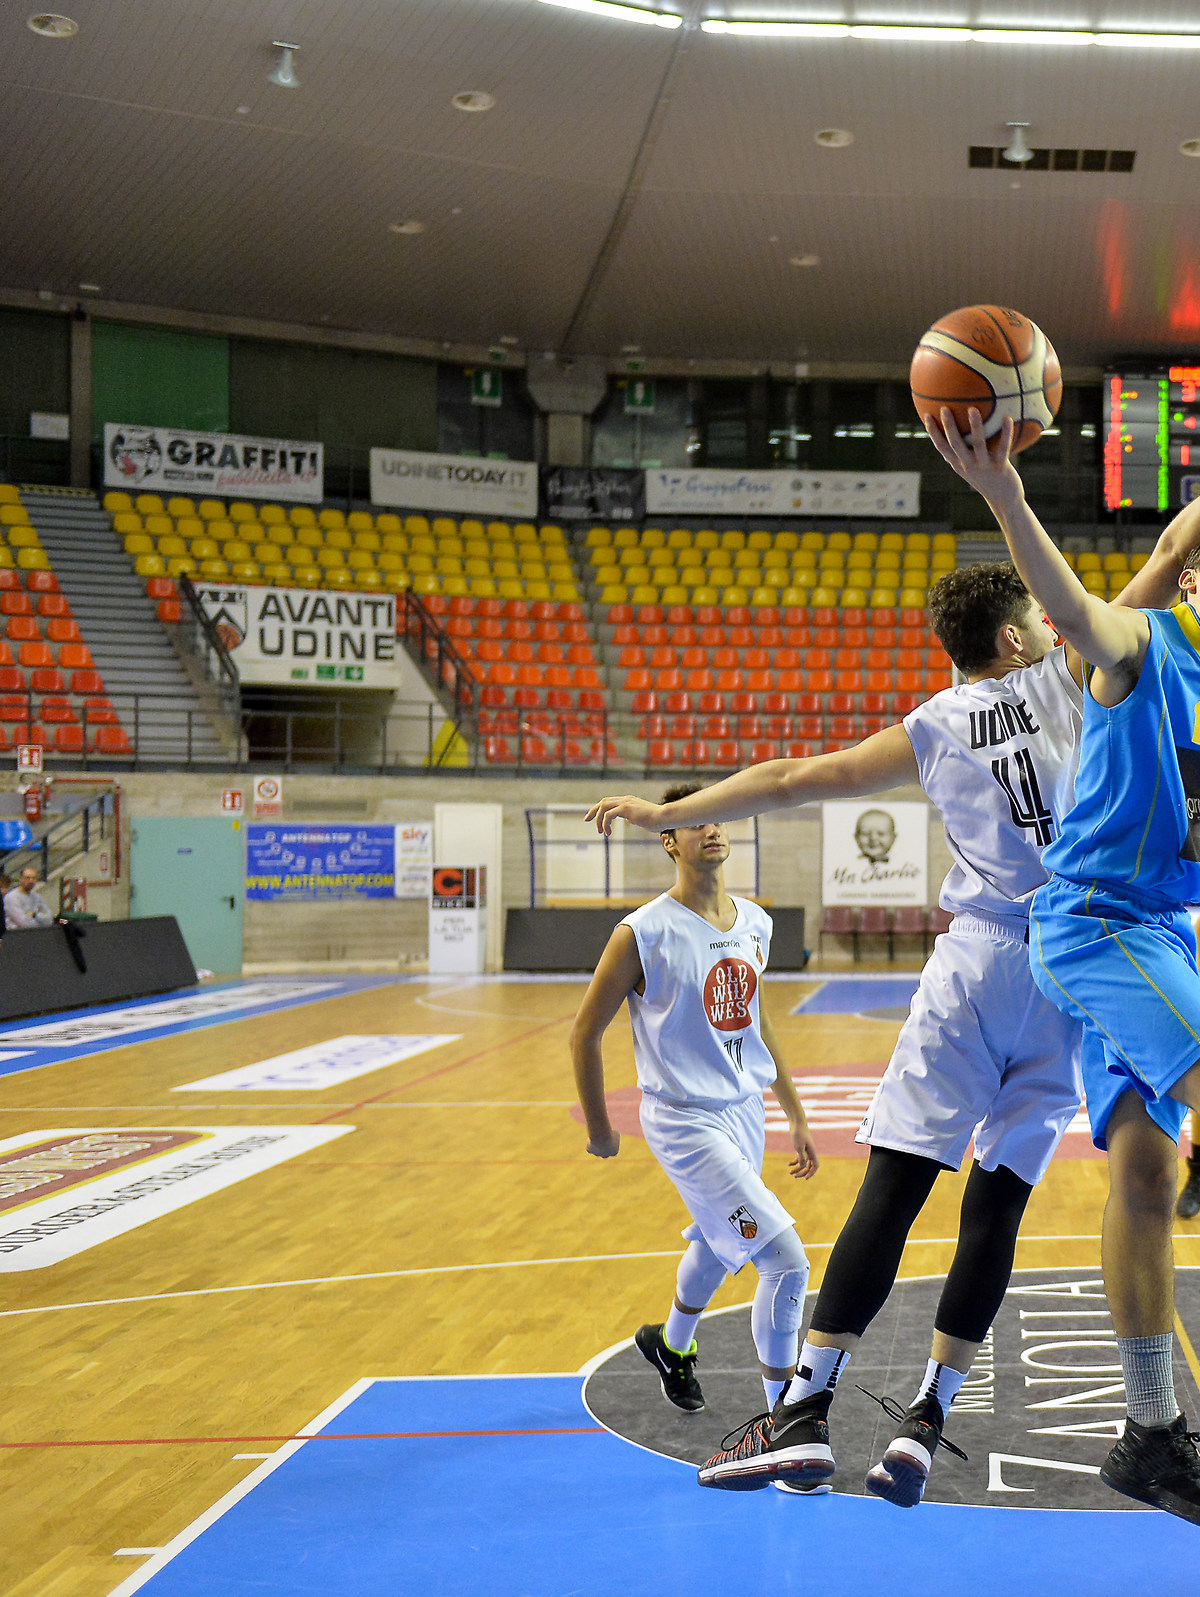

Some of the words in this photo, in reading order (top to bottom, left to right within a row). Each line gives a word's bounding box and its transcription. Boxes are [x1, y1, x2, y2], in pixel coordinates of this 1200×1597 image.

[167, 438, 317, 476] GRAFFITI
[258, 593, 393, 627] AVANTI
[259, 627, 394, 660] UDINE
[991, 747, 1054, 847] 4
[402, 827, 428, 843] sky
[715, 964, 748, 986] OLD
